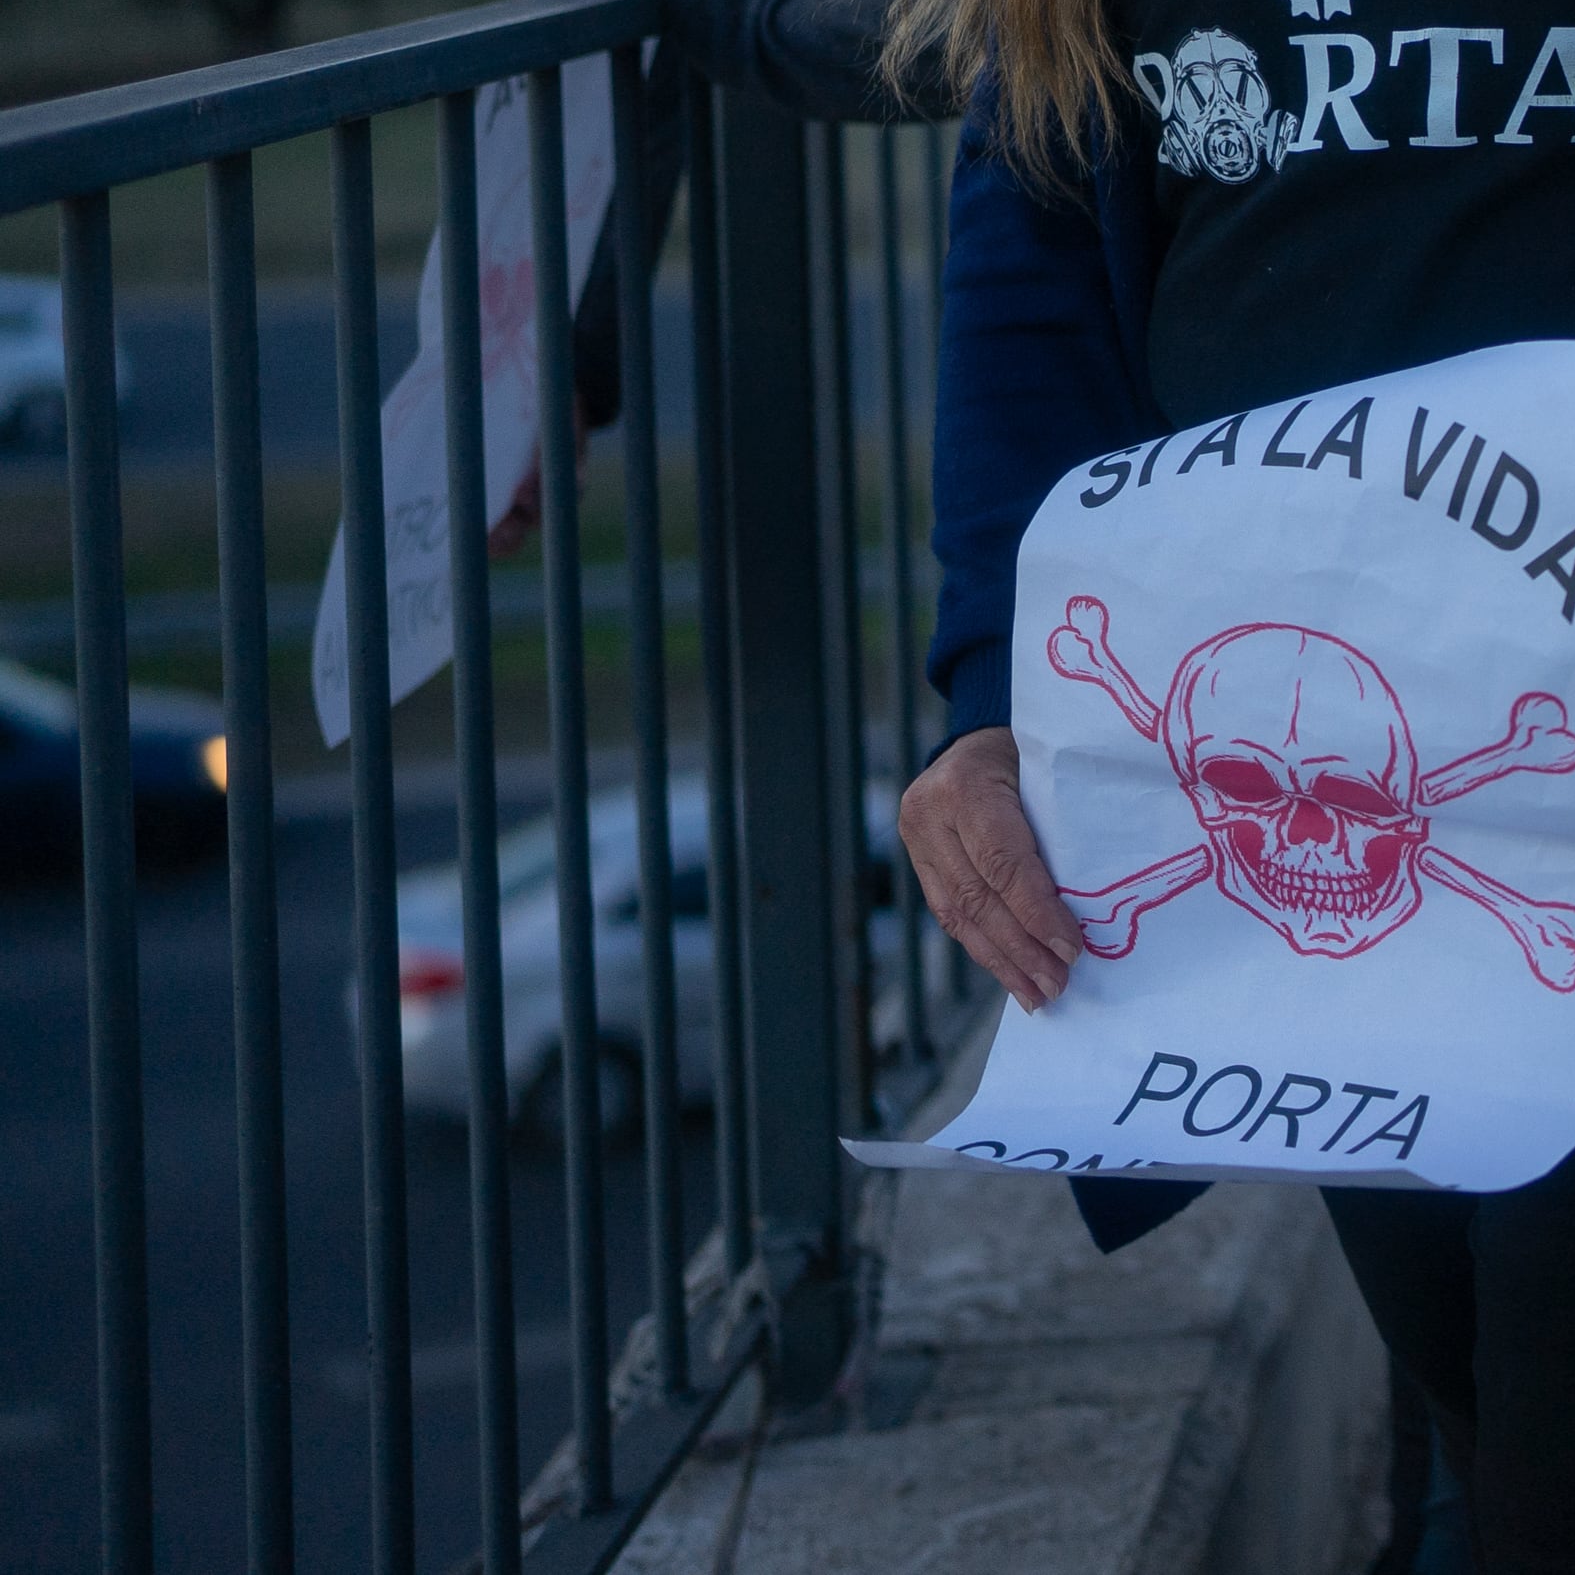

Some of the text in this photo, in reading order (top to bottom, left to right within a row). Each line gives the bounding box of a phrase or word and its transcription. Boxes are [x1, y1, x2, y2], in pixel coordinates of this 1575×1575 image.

[1079, 434, 1178, 509] SI
[1176, 411, 1251, 476] A
[1260, 396, 1375, 480] LA
[1112, 1051, 1430, 1160] PORTA
